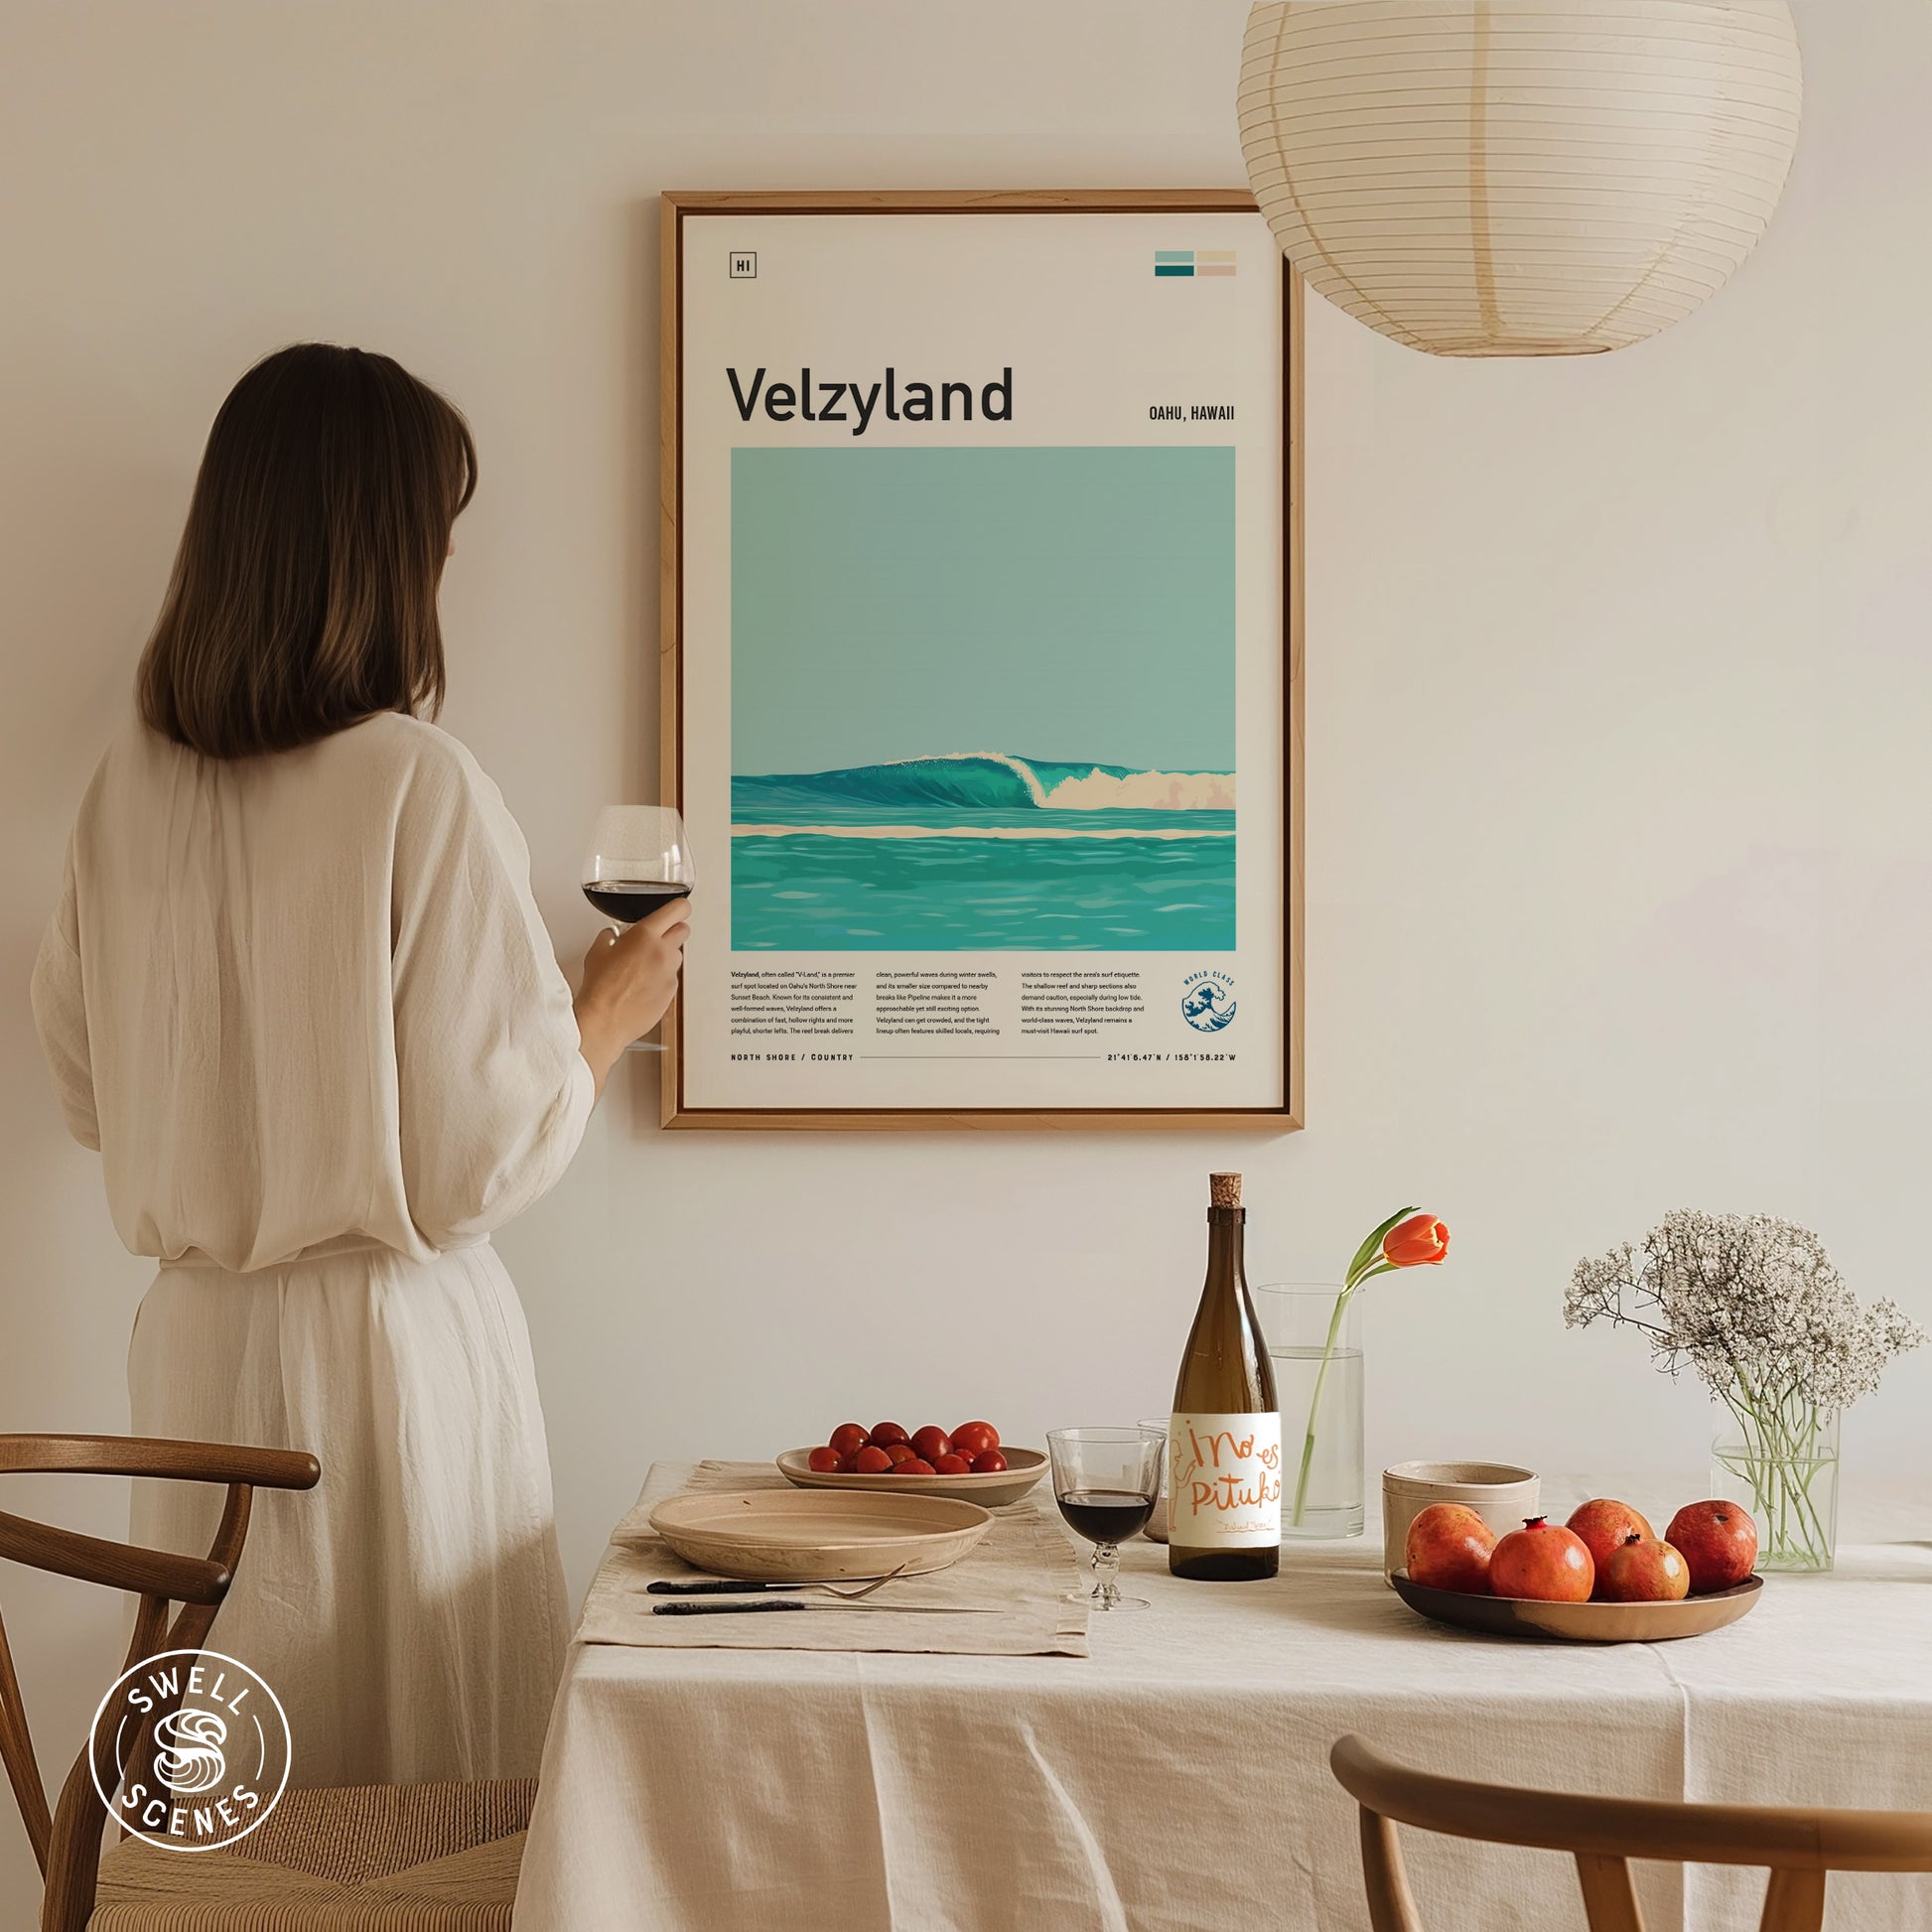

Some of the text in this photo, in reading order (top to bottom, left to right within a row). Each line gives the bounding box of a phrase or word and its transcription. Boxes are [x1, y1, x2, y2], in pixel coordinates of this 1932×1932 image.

[737, 260, 750, 271] HI
[726, 367, 1012, 436] Velzyland
[1149, 405, 1234, 422] OAHU, HAWAII
[894, 971, 919, 980] powerful
[939, 971, 958, 980] during
[1183, 970, 1234, 986] WORLD CLASS
[931, 982, 960, 991] compared
[969, 983, 988, 992] nearby
[1081, 982, 1098, 991] sharp
[907, 993, 930, 1003] Pipeline
[1069, 994, 1098, 1003] especially
[1099, 994, 1117, 1003] during
[786, 1005, 813, 1014] Velzyland
[877, 1005, 914, 1014] approachable
[1105, 1005, 1132, 1014] backdrop
[808, 1017, 825, 1026] rights
[877, 1017, 903, 1026] Velzyland
[916, 1017, 925, 1026] get
[976, 1017, 989, 1026] tight
[1075, 1017, 1103, 1026] Velzyland
[975, 1028, 1000, 1036] requiring
[1256, 1444, 1279, 1470] es
